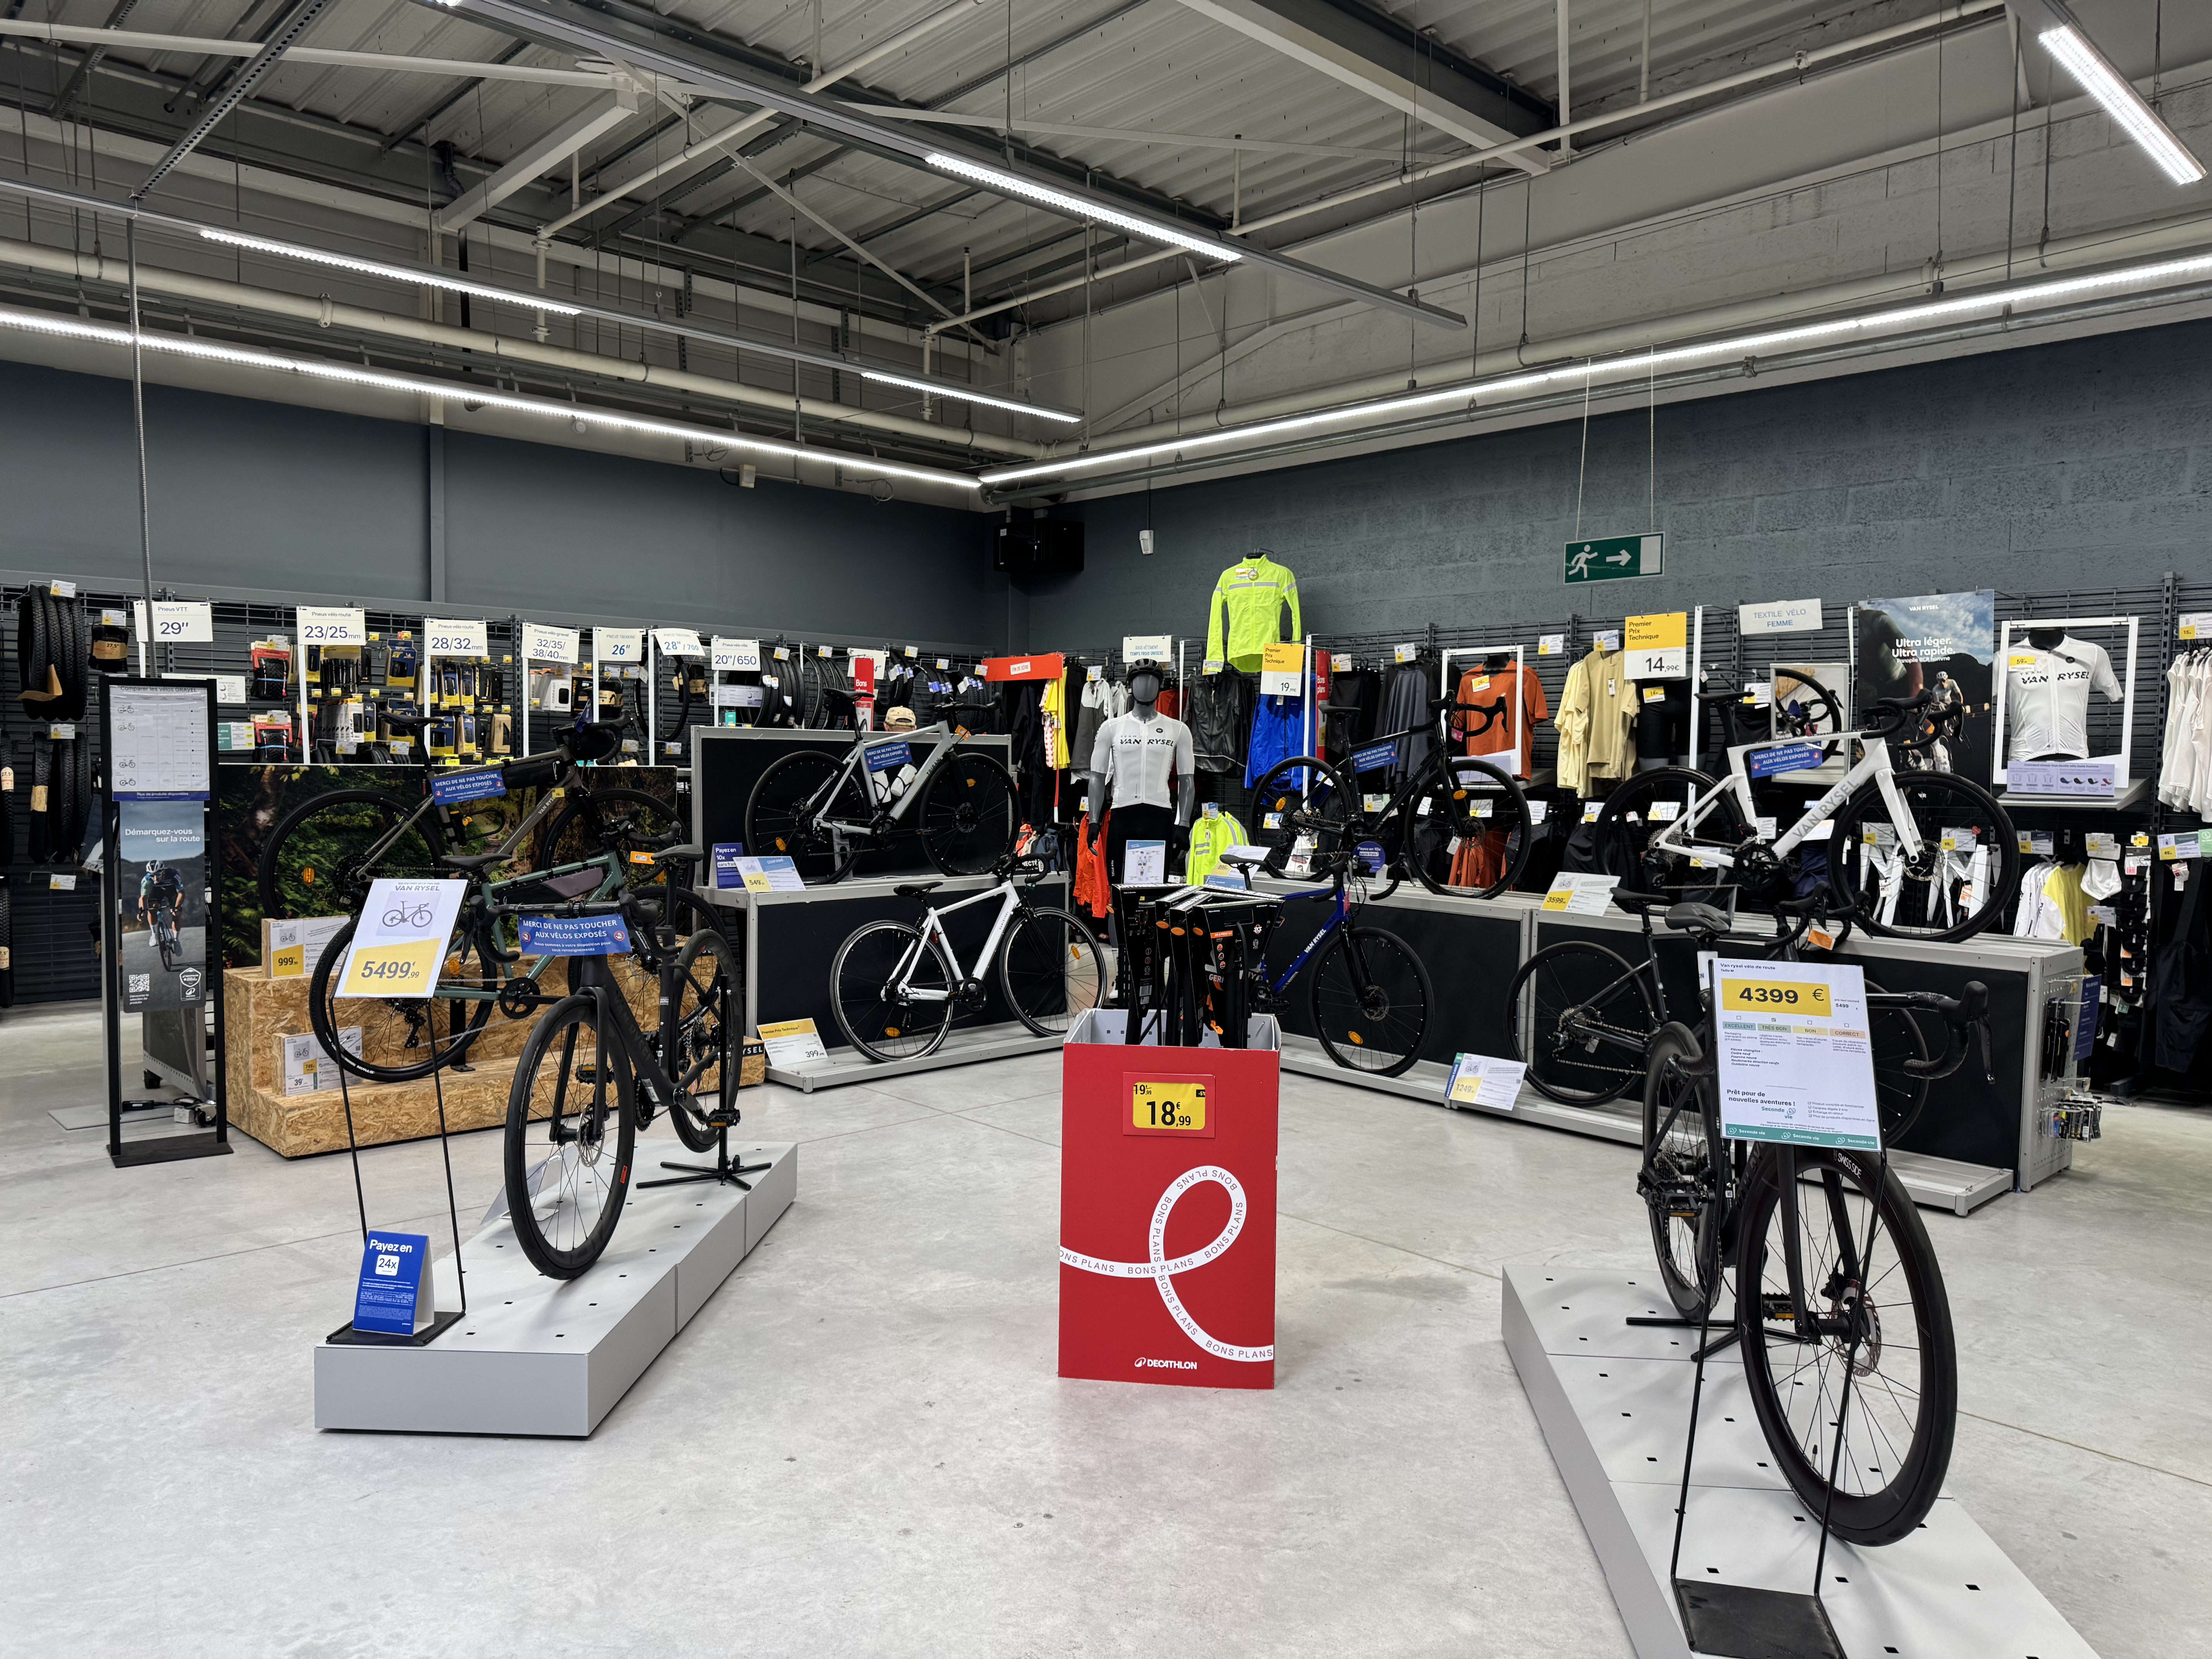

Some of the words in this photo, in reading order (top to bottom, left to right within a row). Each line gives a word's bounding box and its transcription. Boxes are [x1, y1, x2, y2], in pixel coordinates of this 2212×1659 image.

[537, 639, 566, 651] 32/35/
[612, 644, 630, 655] 26"
[1896, 638, 1921, 647] Ultra
[1924, 636, 1952, 647] léger.
[1892, 648, 1917, 658] Ultra
[1920, 646, 1956, 657] rapide.
[2021, 675, 2049, 684] VAN
[1792, 814, 1822, 838] VAN
[1819, 780, 1860, 815] RYSEL
[523, 920, 542, 928] MERCI
[580, 920, 617, 929] TOUCHER
[551, 931, 572, 939] VÉLOS
[574, 929, 607, 939] EXPOSÉS
[1304, 941, 1314, 953] VAN
[1312, 928, 1327, 943] RYSEL
[1739, 987, 1798, 1004] 4399
[1812, 988, 1824, 1001] €
[1838, 1152, 1852, 1170] SWISS
[1176, 1169, 1208, 1190] PLANS
[1212, 1170, 1237, 1191] BONS
[1155, 1196, 1172, 1225] BONS
[1204, 1236, 1230, 1259] BONS
[1228, 1202, 1243, 1235] PLANS
[369, 1239, 398, 1253] Payez
[400, 1244, 412, 1253] en
[1152, 1227, 1161, 1262] PLANS
[378, 1258, 397, 1269] 24x
[1081, 1259, 1115, 1272] PLANS
[1128, 1266, 1156, 1274] BONS
[1161, 1258, 1194, 1273] PLANS
[1158, 1275, 1175, 1304] BONS
[1173, 1305, 1198, 1336] PLANS
[1206, 1340, 1234, 1356] BONS
[1238, 1349, 1273, 1358] PLANS
[1147, 1359, 1197, 1370] DECATHLON
